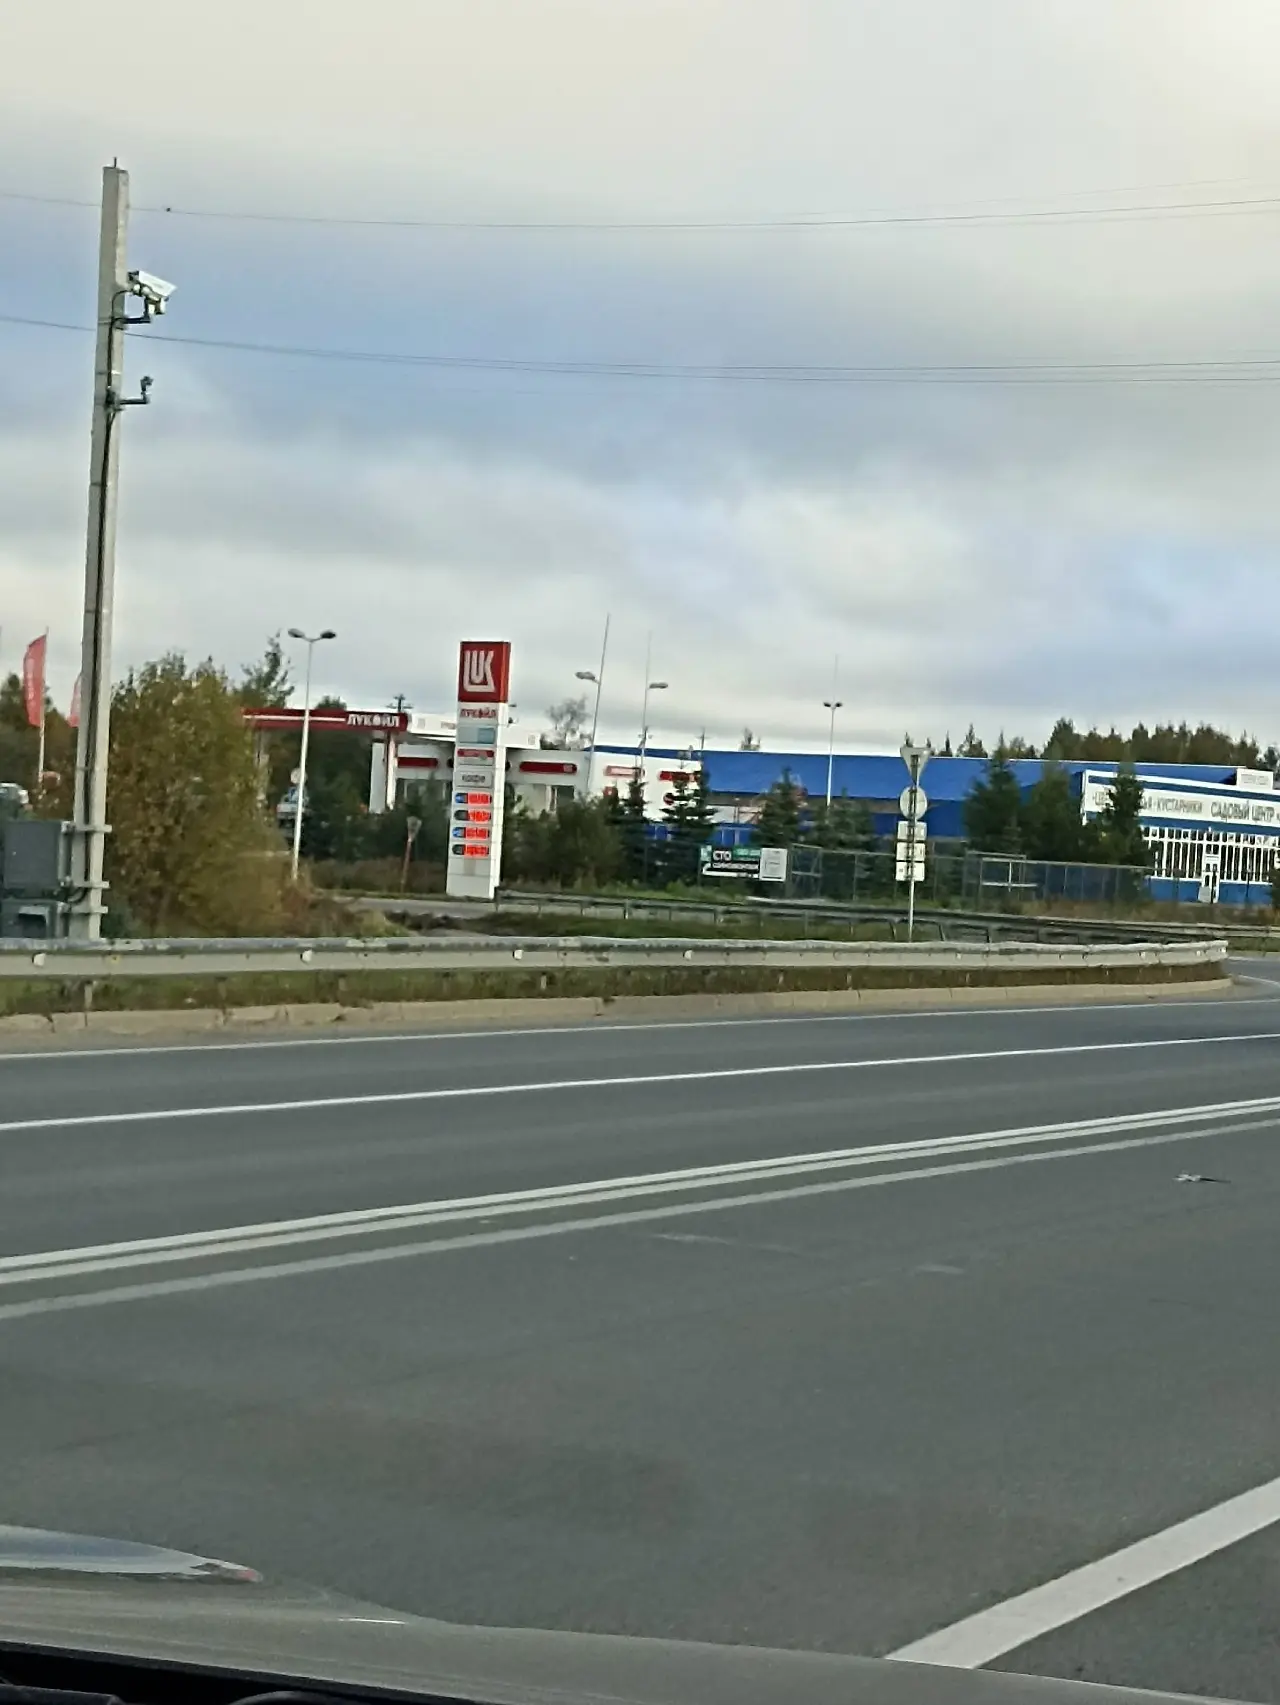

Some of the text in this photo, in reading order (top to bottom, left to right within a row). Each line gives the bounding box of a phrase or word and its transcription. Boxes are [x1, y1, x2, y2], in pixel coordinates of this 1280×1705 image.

[460, 707, 497, 719] ЛУКОЙЛ
[347, 713, 401, 728] ЛУКОЙЛ
[1211, 800, 1250, 822] САДОВЫЙ
[1252, 804, 1275, 823] ЦЕНТР
[713, 849, 732, 861] СТО
